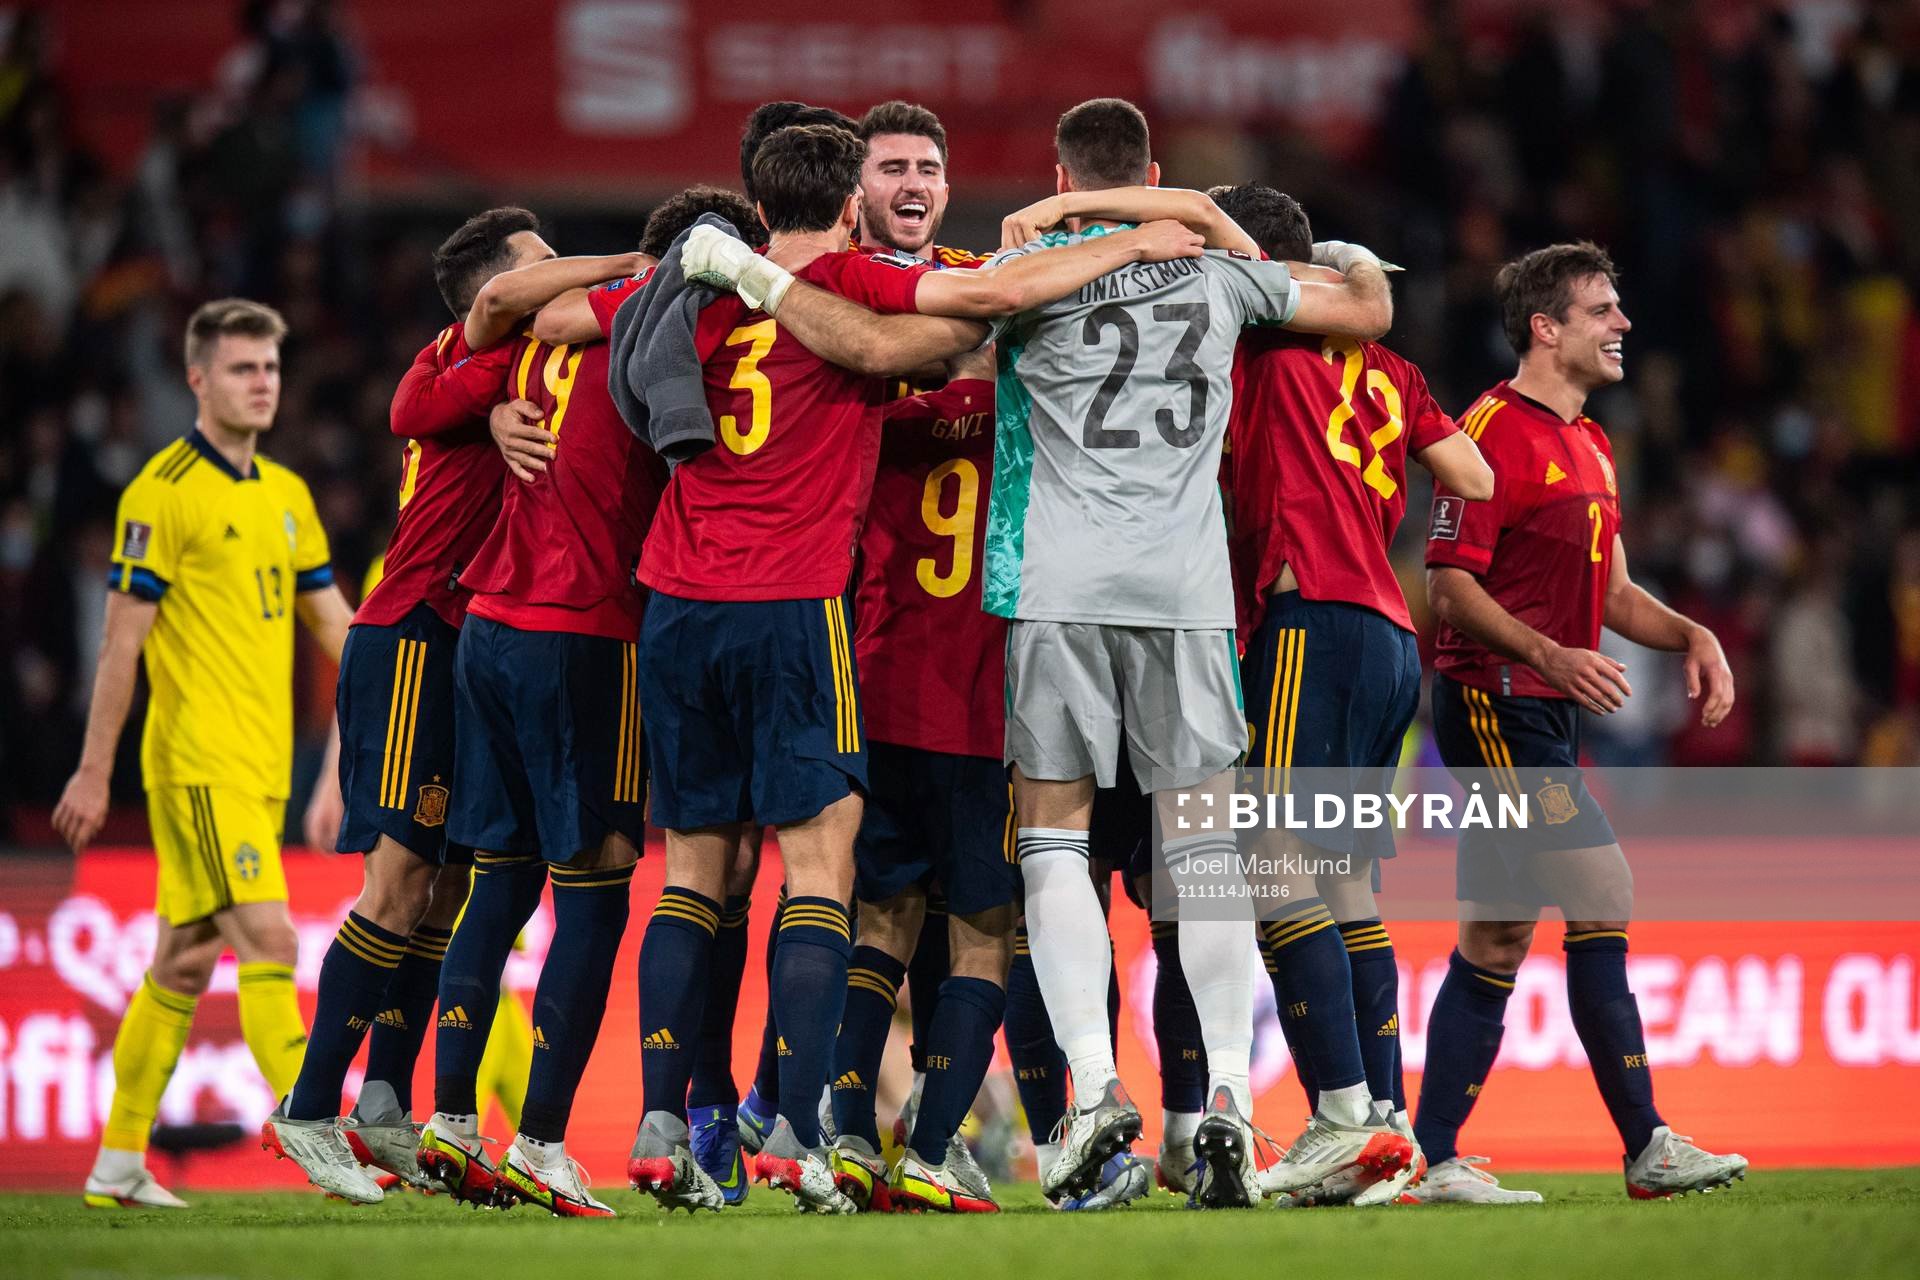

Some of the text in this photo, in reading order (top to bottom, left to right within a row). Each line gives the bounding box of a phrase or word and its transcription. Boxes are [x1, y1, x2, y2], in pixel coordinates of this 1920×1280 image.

[720, 318, 777, 456] 3
[931, 411, 989, 441] GAVI
[1083, 303, 1210, 448] 23
[1321, 336, 1403, 500] 22
[916, 458, 980, 598] 9
[1588, 501, 1603, 563] 2
[438, 1020, 473, 1031] adidas
